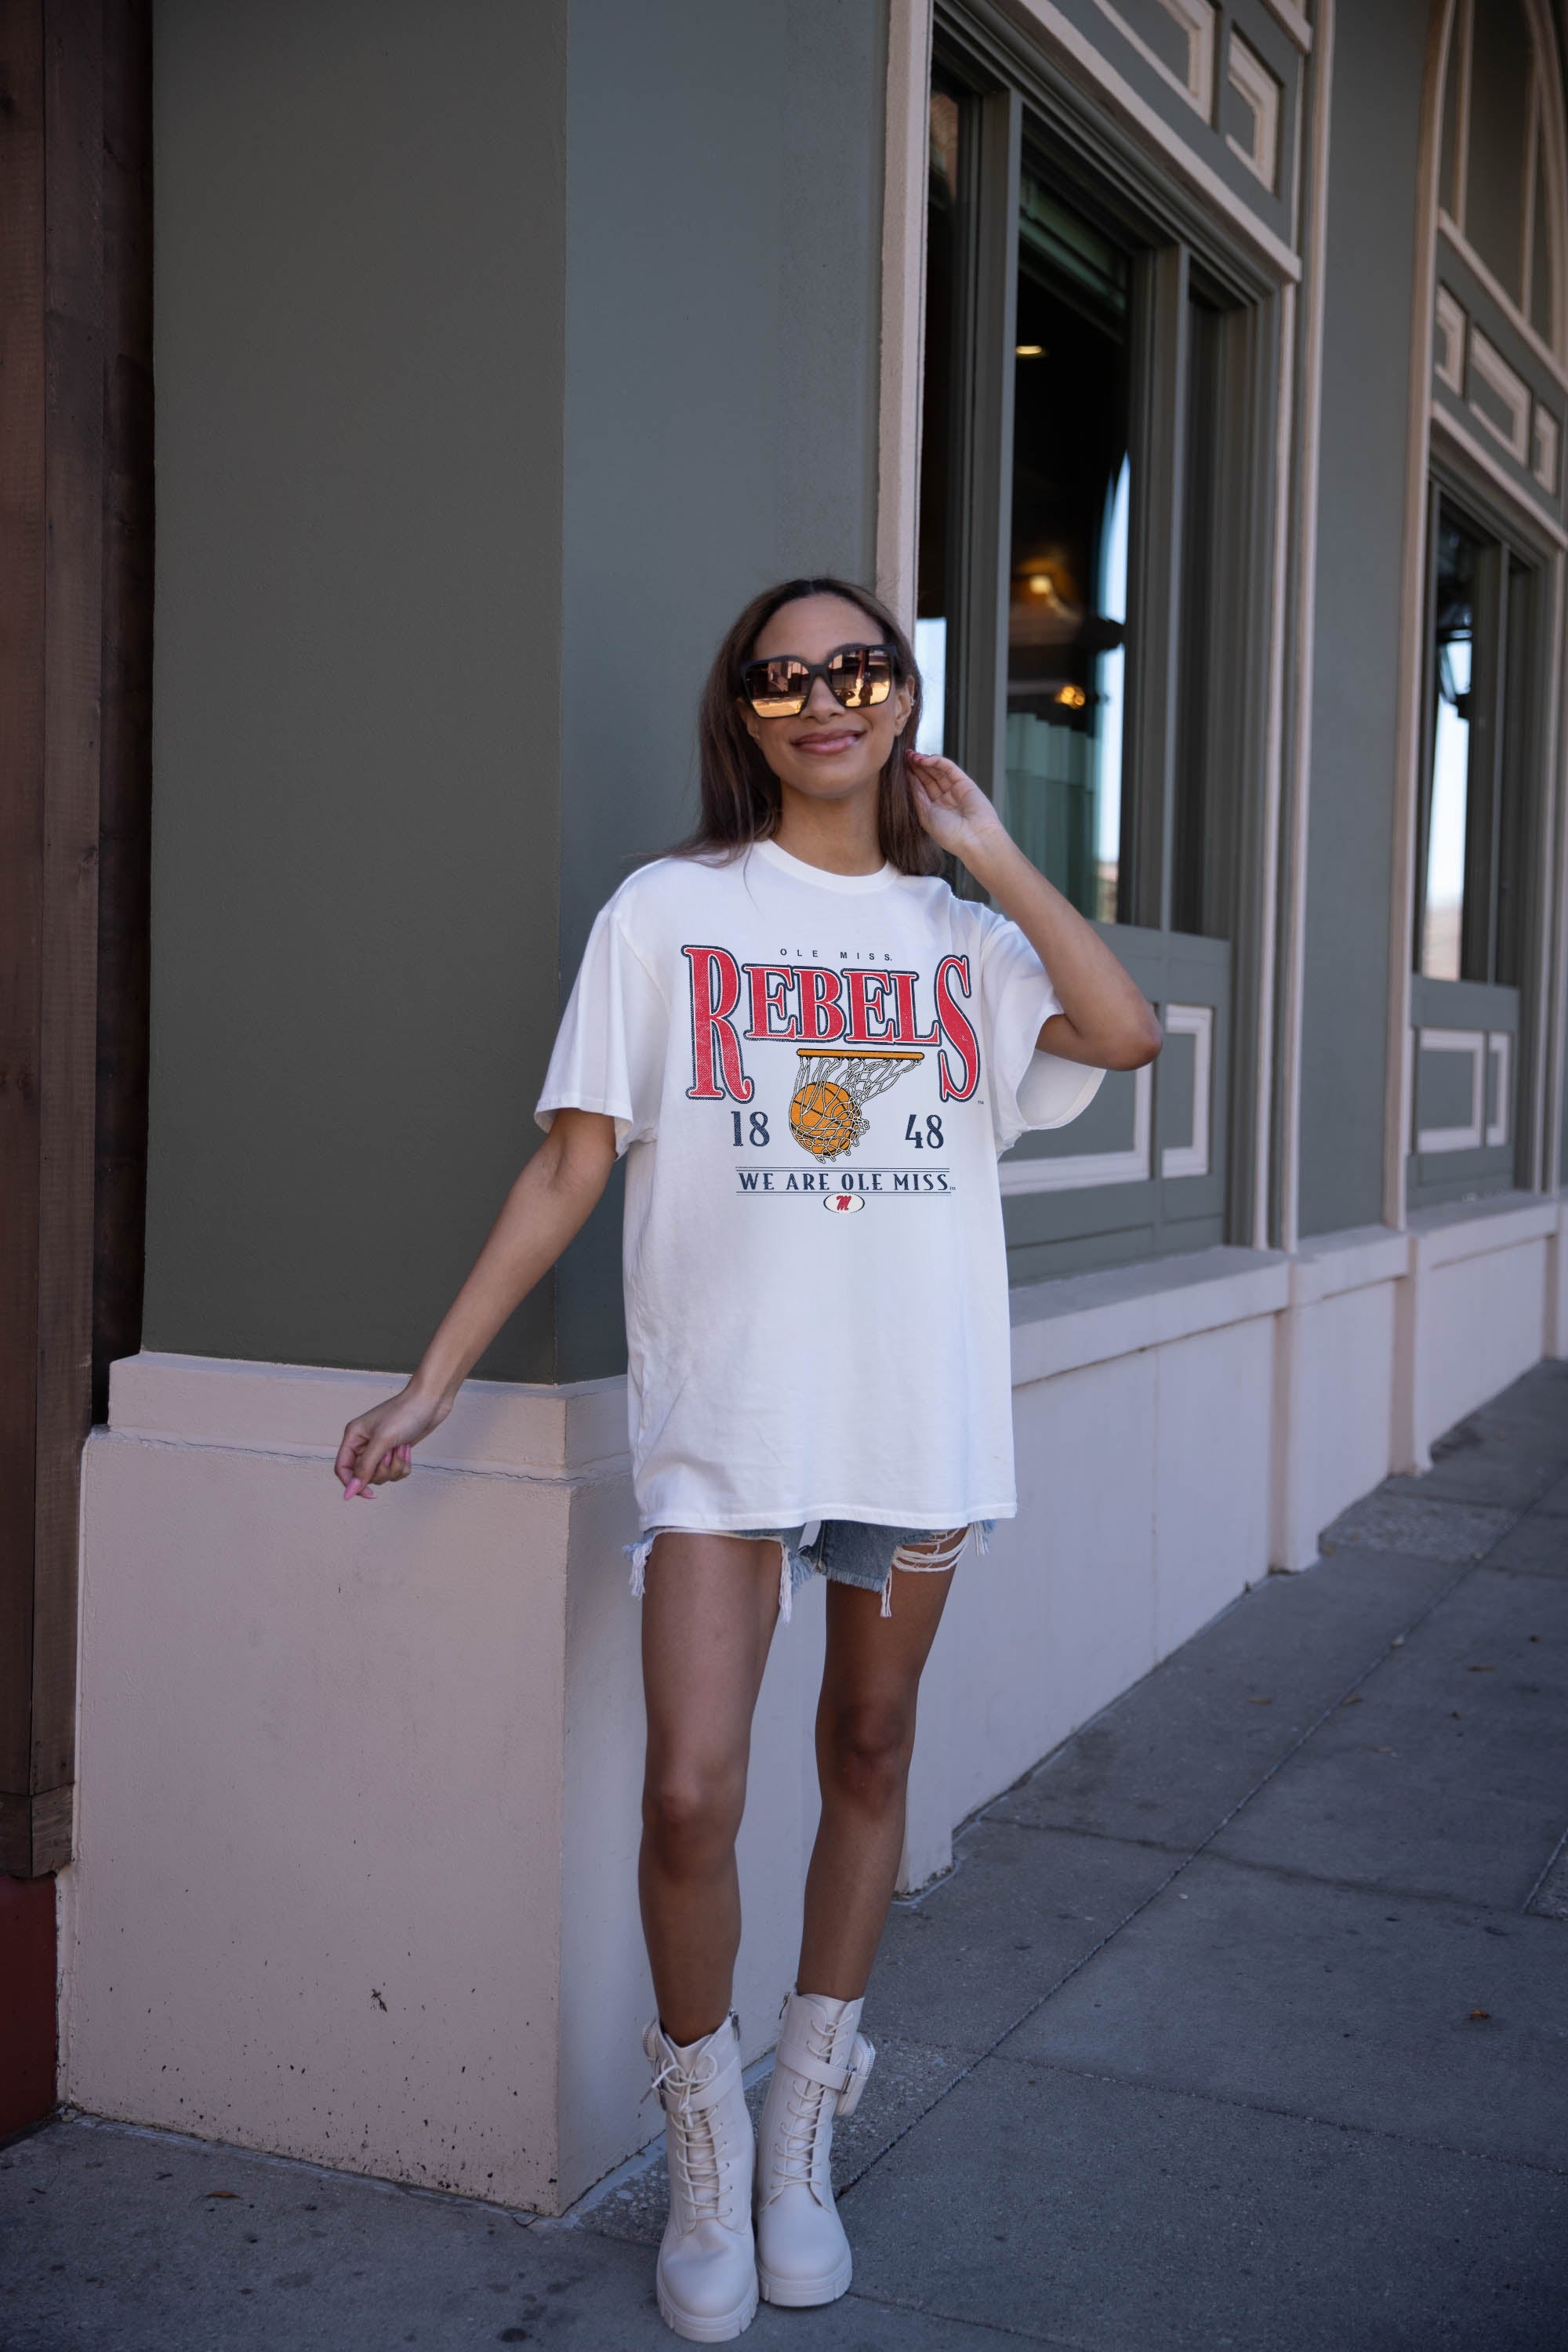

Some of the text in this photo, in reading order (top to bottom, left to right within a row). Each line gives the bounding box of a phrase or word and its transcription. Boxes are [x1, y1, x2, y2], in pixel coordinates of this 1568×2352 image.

[780, 948, 818, 957] OLE
[681, 945, 980, 1103] REBELS
[731, 1110, 945, 1149] 18 48
[739, 1173, 775, 1191] WE
[785, 1174, 830, 1191] ARE
[840, 1173, 884, 1191] OLE
